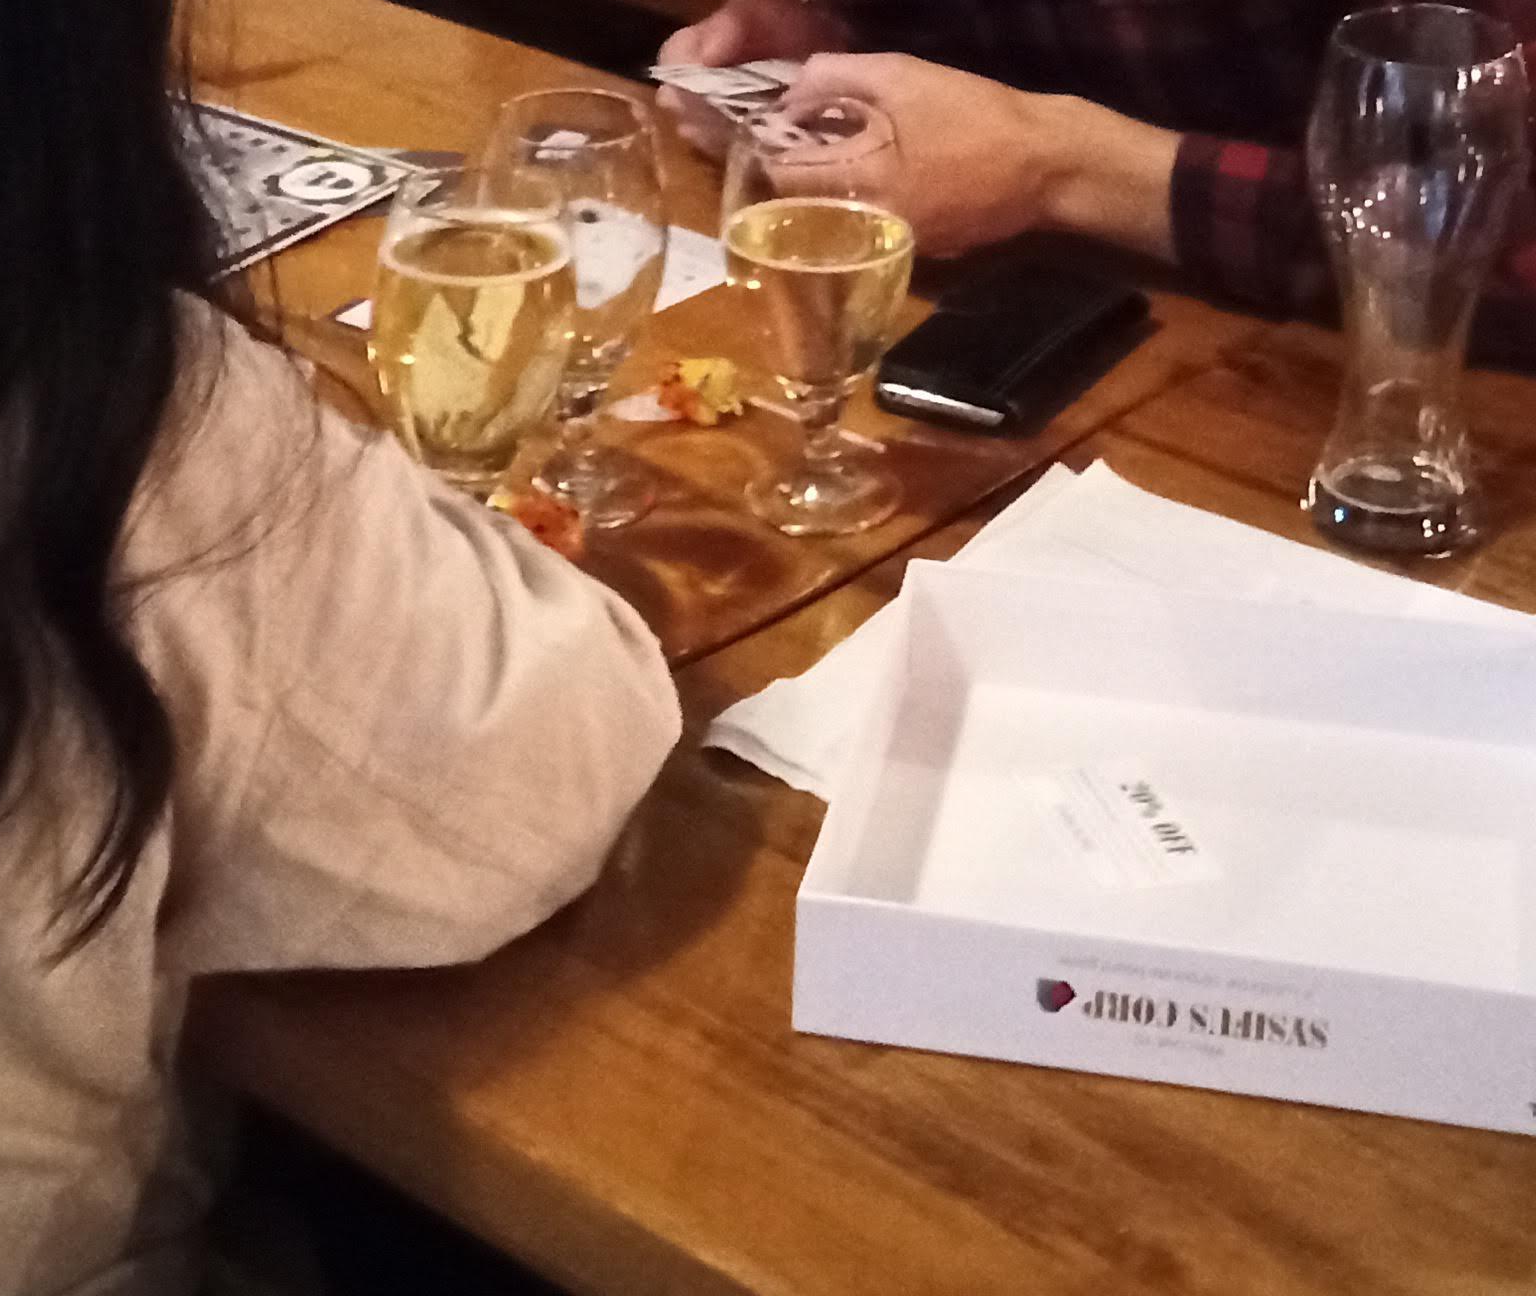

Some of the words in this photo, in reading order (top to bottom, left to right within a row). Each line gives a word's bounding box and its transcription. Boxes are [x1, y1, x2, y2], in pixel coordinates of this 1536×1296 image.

[1150, 822, 1199, 855] OFF
[1080, 989, 1178, 1029] CORP
[1189, 1004, 1330, 1049] SYSIFUS
